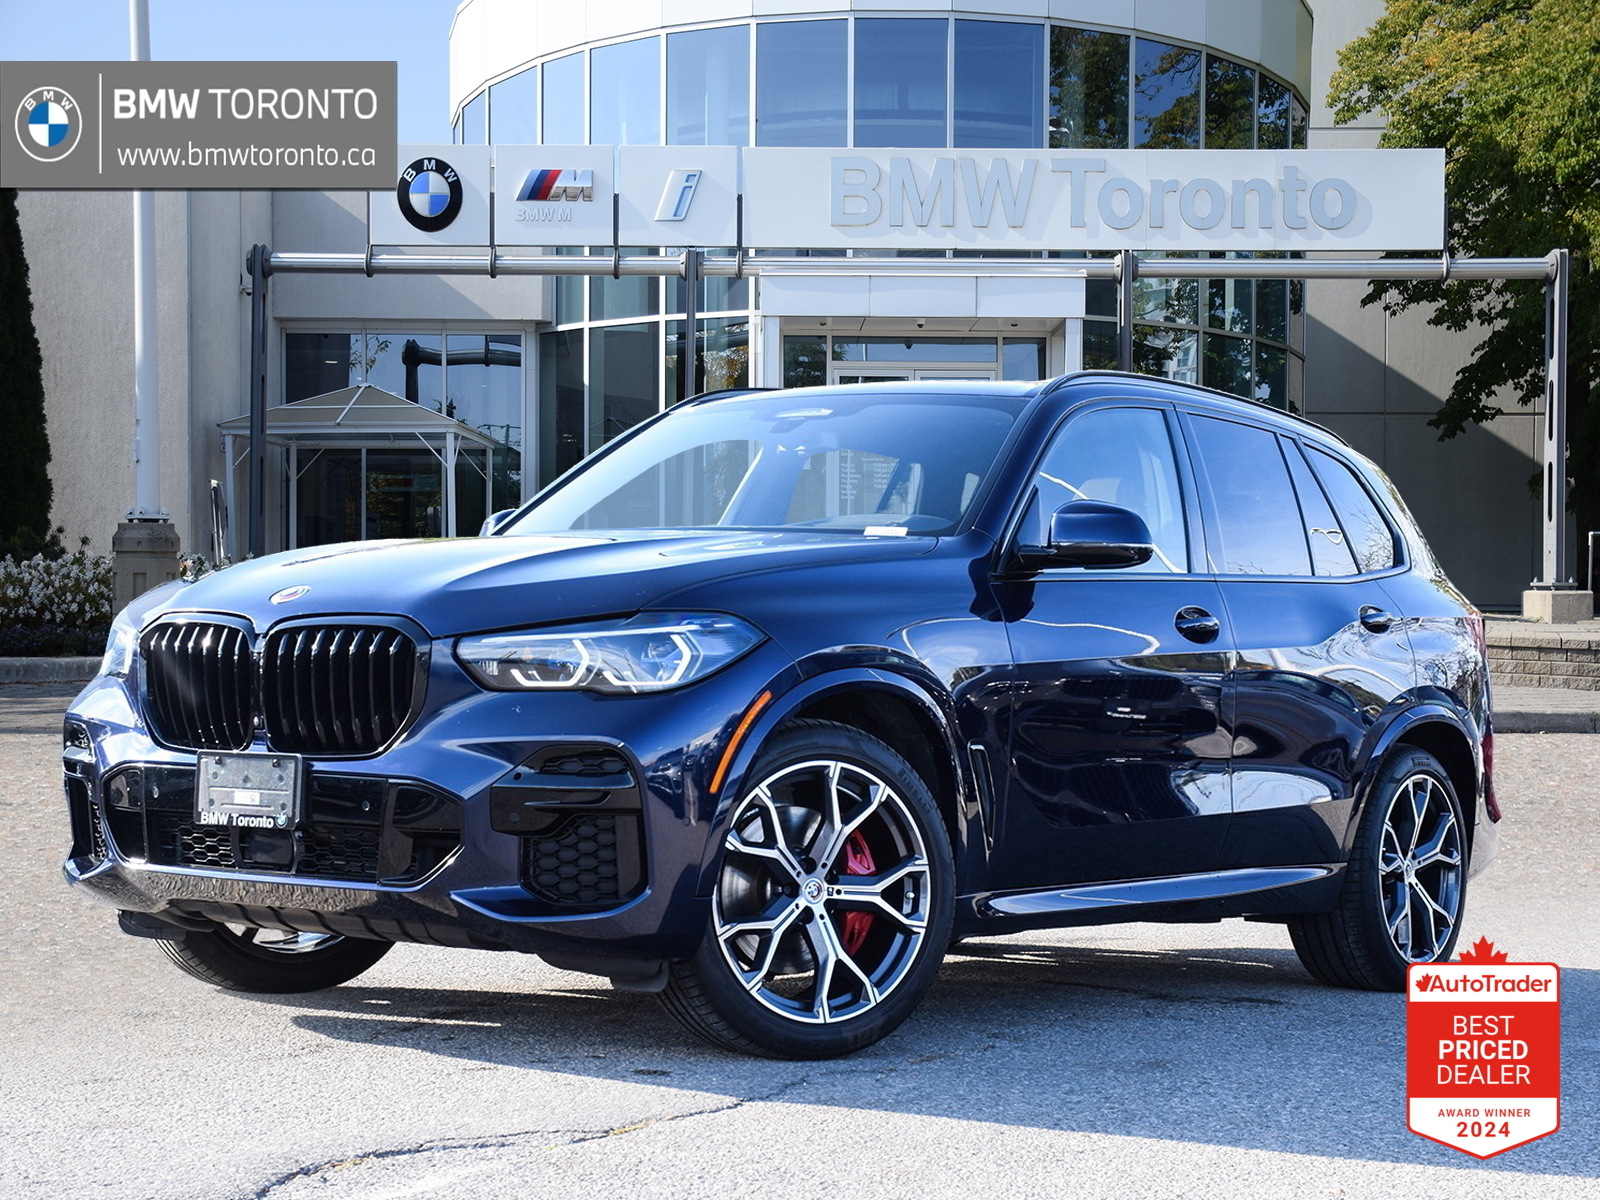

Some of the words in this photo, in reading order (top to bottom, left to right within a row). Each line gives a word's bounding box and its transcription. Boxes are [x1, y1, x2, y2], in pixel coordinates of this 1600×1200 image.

[830, 156, 1039, 229] BMW
[1050, 157, 1358, 231] Toronto
[515, 207, 555, 222] BMW
[557, 207, 573, 222] M
[200, 811, 230, 826] BMW
[231, 813, 274, 829] Toronto
